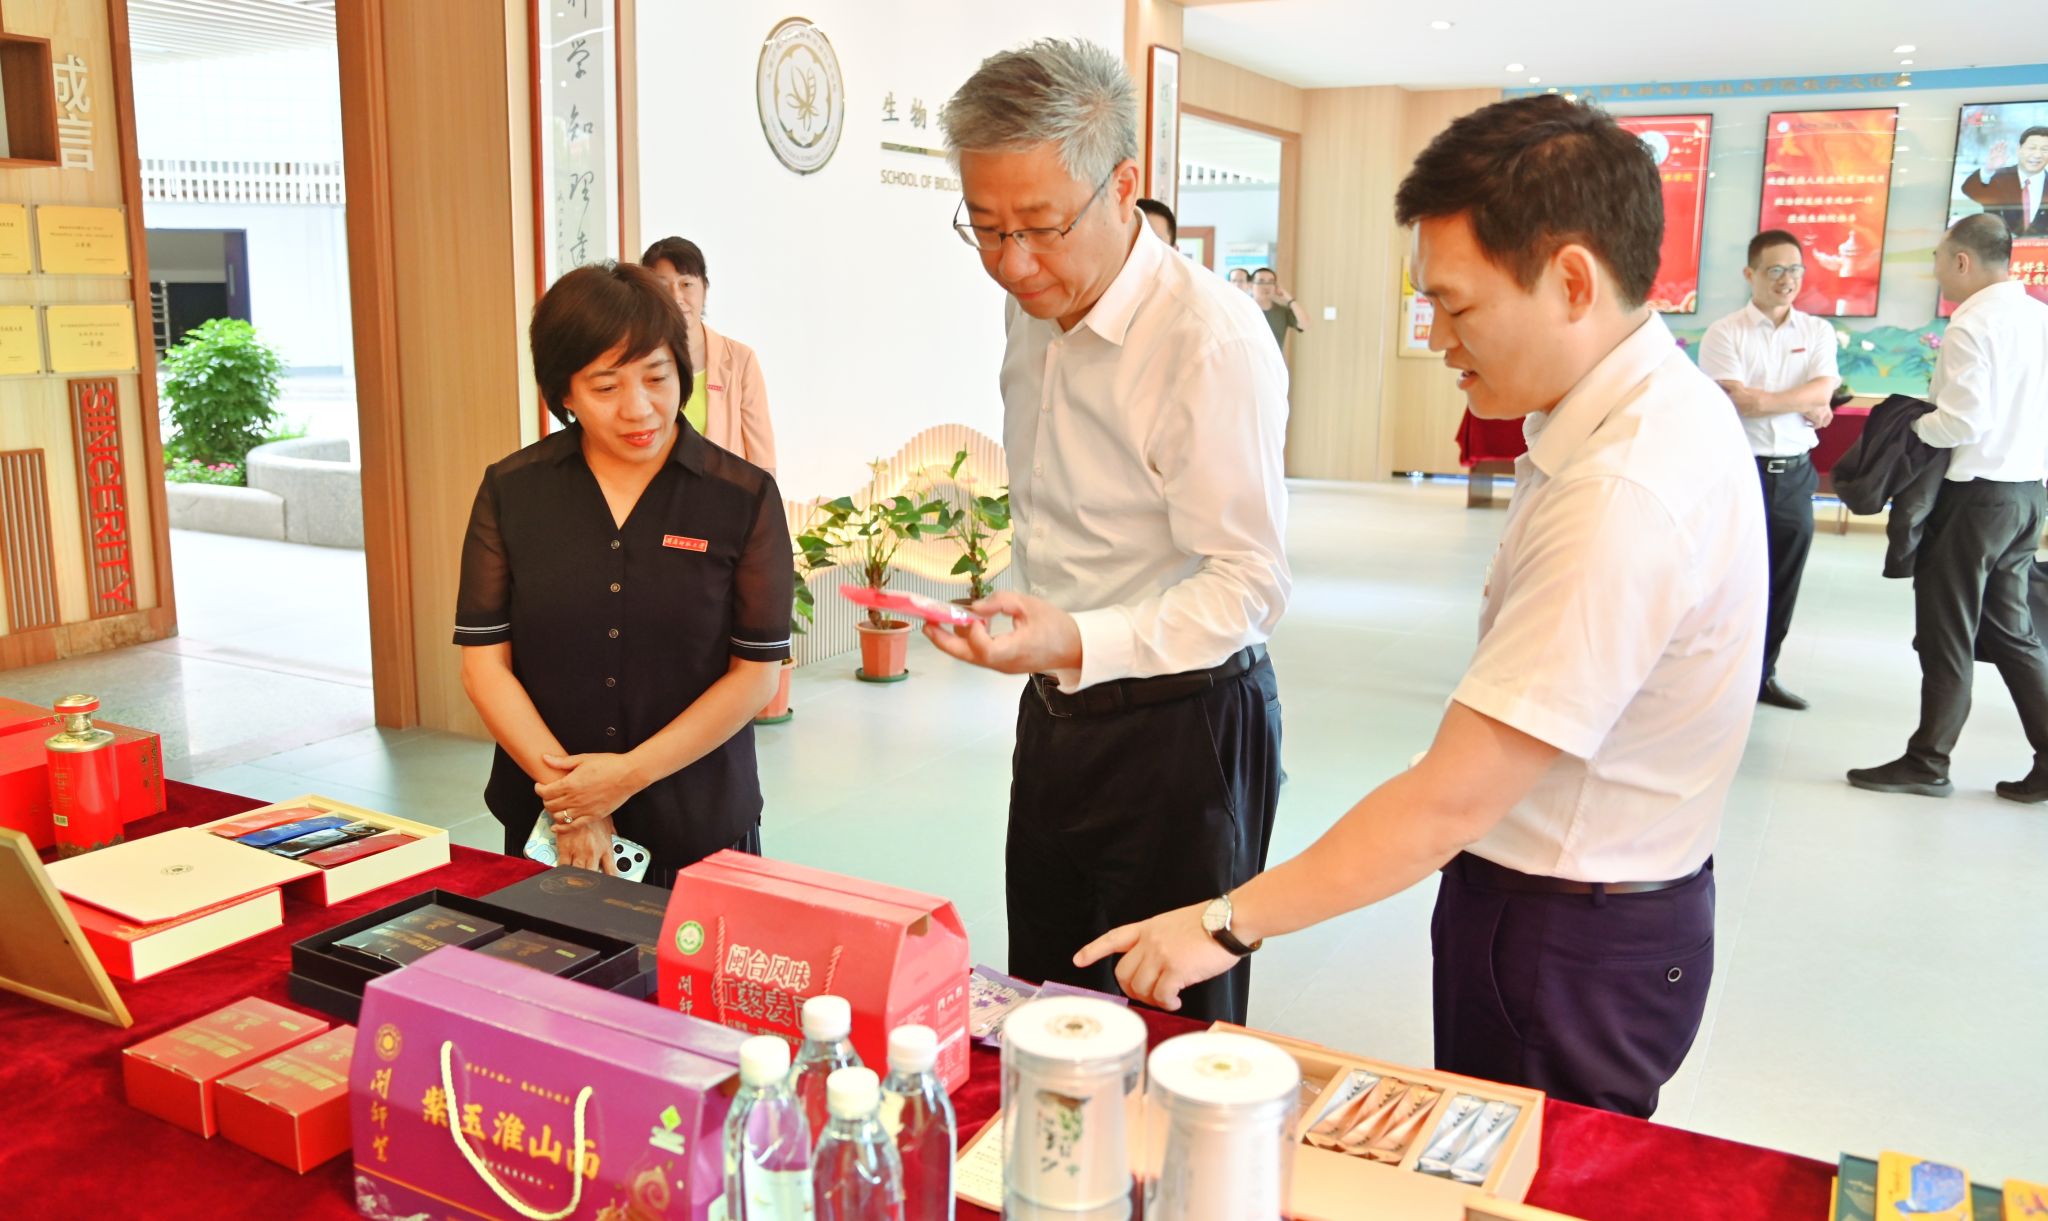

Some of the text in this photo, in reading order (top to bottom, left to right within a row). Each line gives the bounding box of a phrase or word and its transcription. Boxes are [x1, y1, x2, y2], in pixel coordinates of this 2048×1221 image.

[881, 169, 962, 191] SCHOOL OF BIOLO
[82, 387, 135, 608] SINCERITY
[725, 943, 811, 993] 闽台风味
